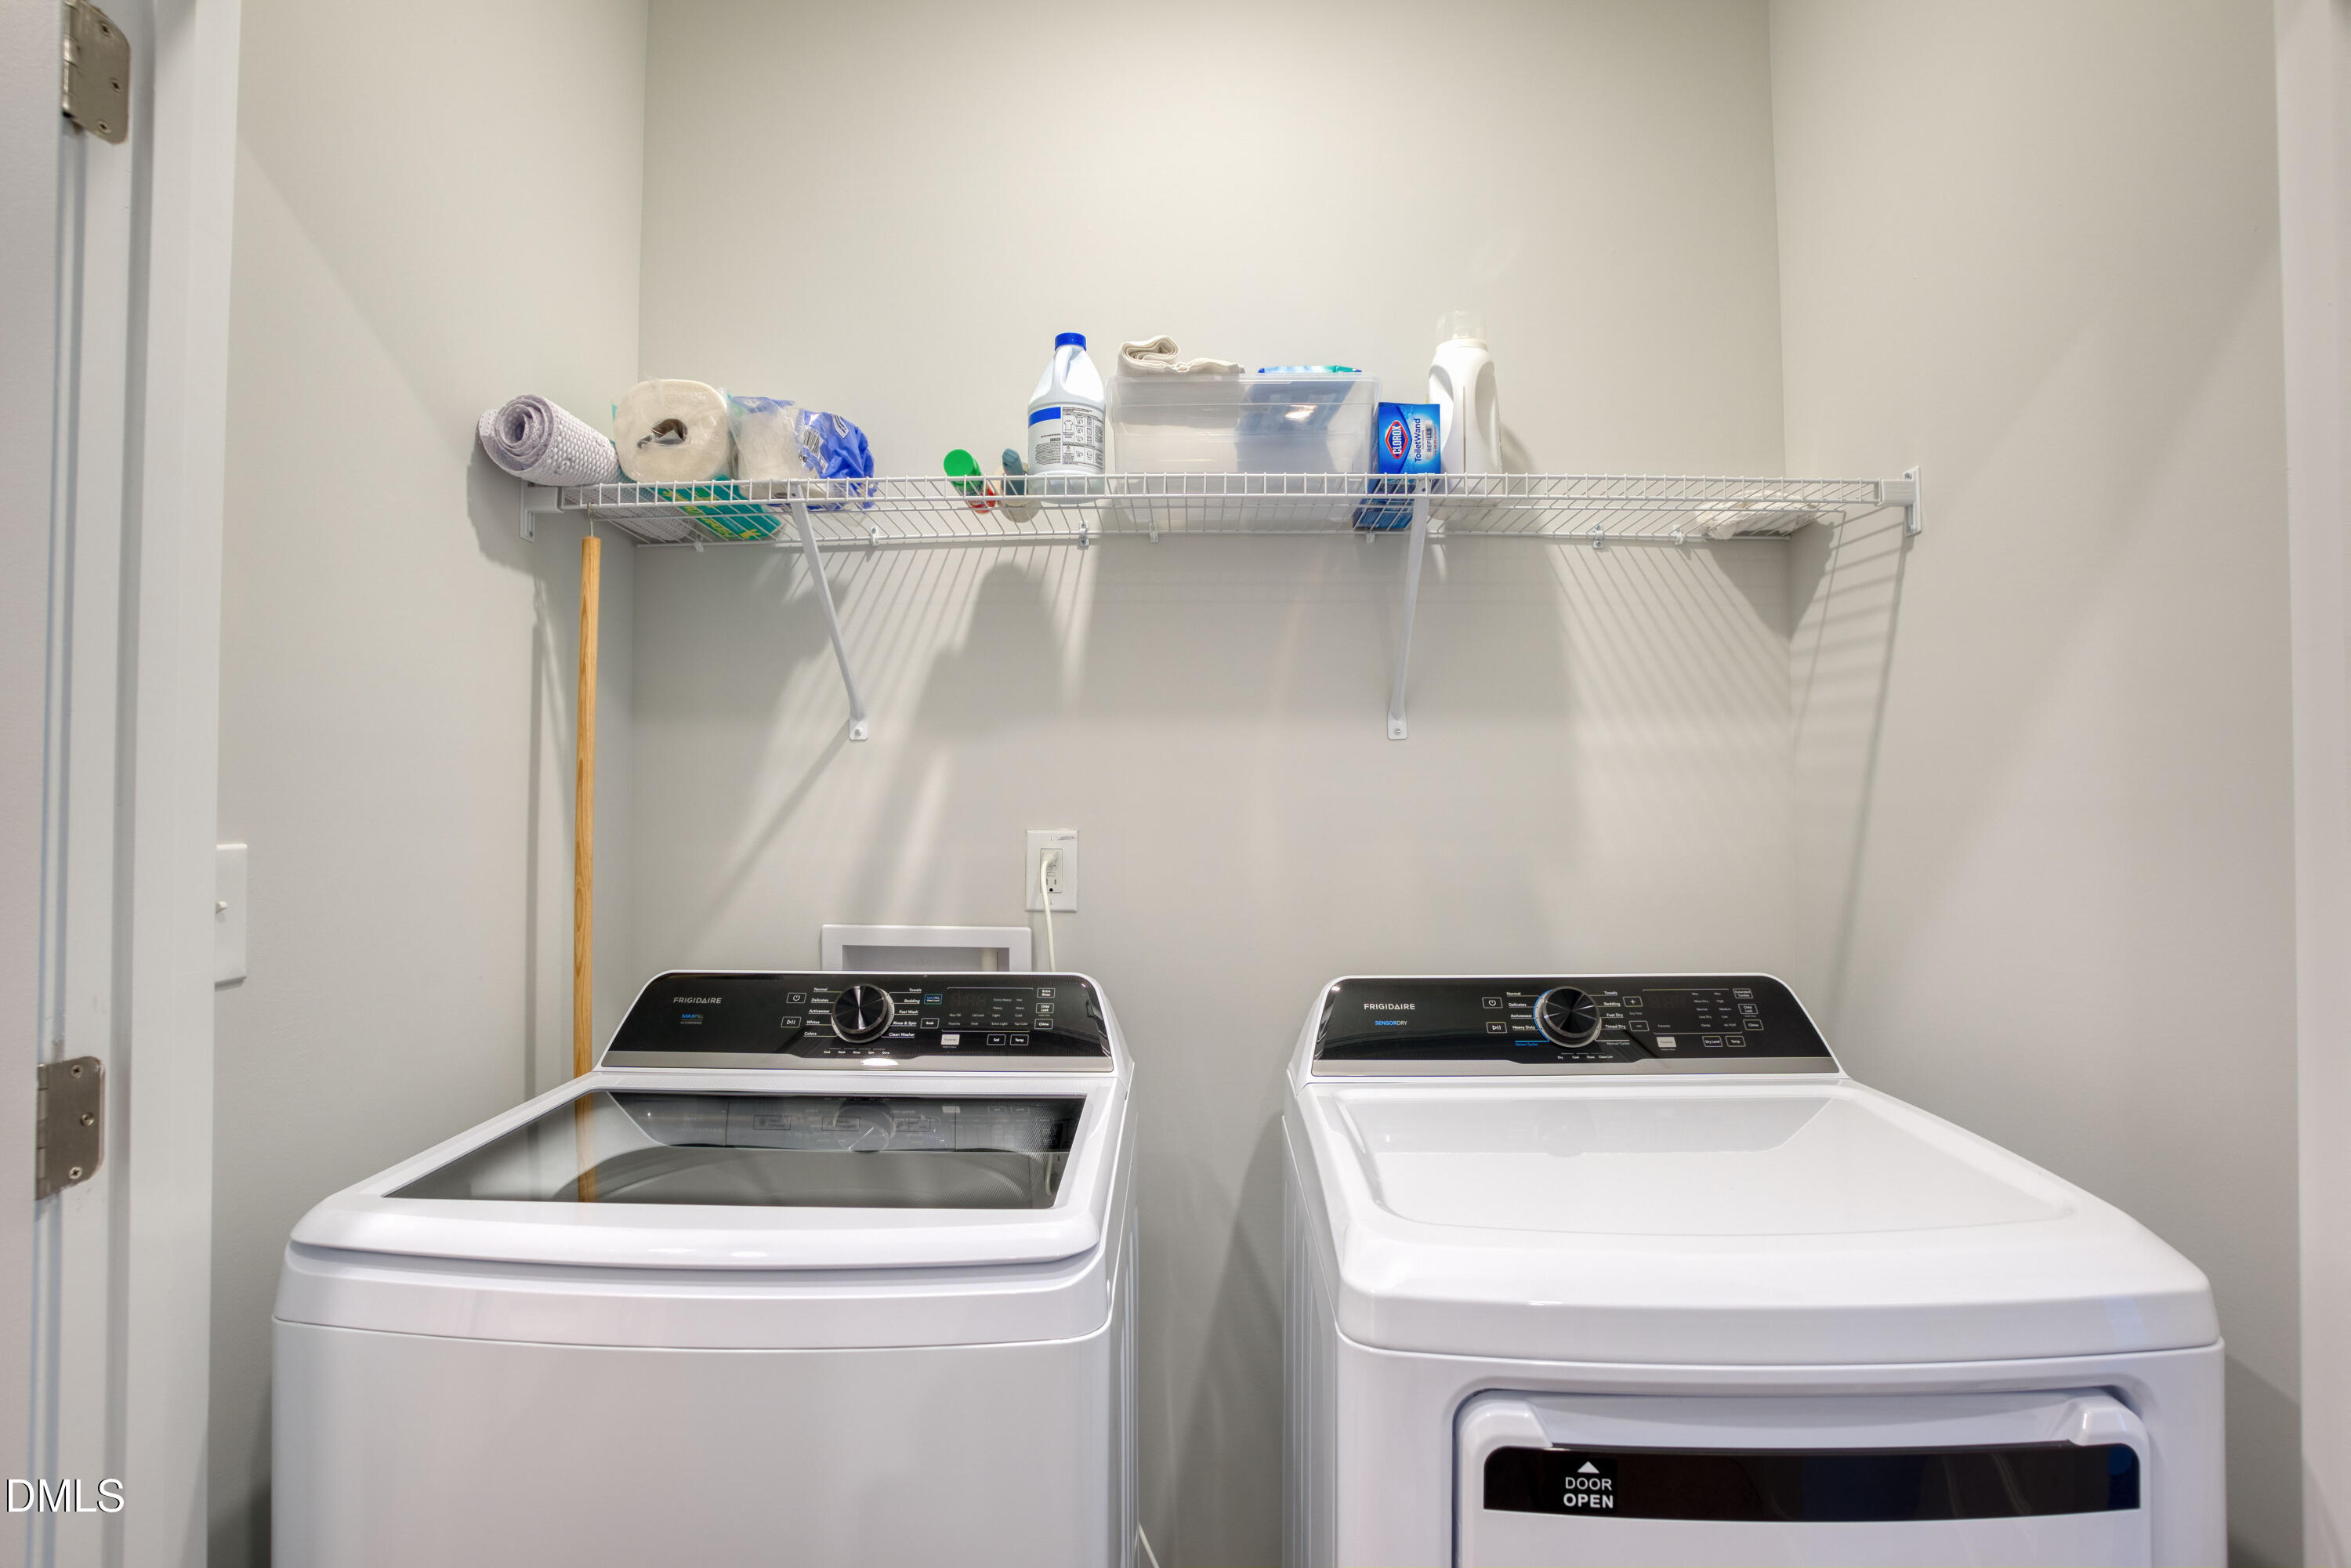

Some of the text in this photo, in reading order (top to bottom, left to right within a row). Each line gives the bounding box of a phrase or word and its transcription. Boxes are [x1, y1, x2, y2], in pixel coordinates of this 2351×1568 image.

[1392, 425, 1402, 454] CLOROX
[1565, 1476, 1613, 1490] DOOR
[1563, 1493, 1614, 1508] OPEN
